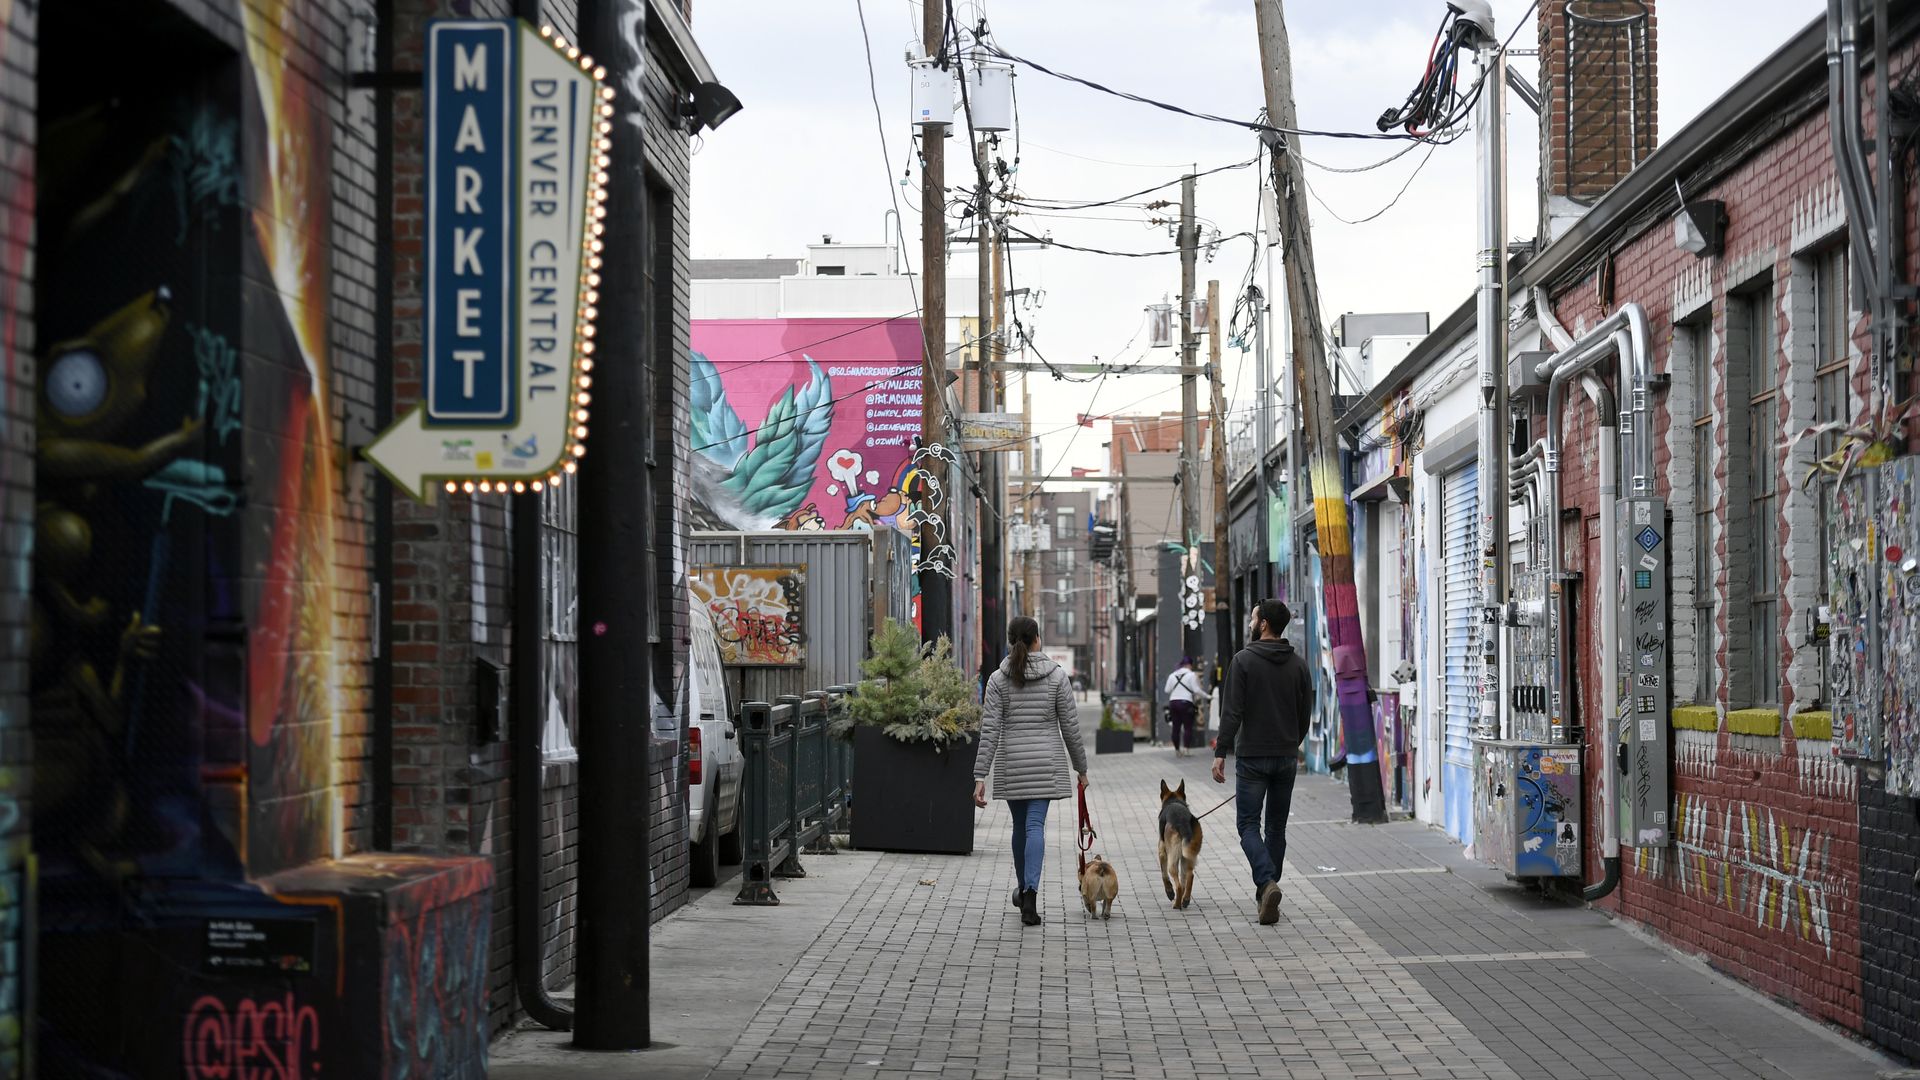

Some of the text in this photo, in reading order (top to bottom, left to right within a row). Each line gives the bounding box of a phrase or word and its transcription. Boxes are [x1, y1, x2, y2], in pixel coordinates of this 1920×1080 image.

[453, 43, 487, 399] MARKET
[529, 79, 558, 400] DENVER CENTRAL
